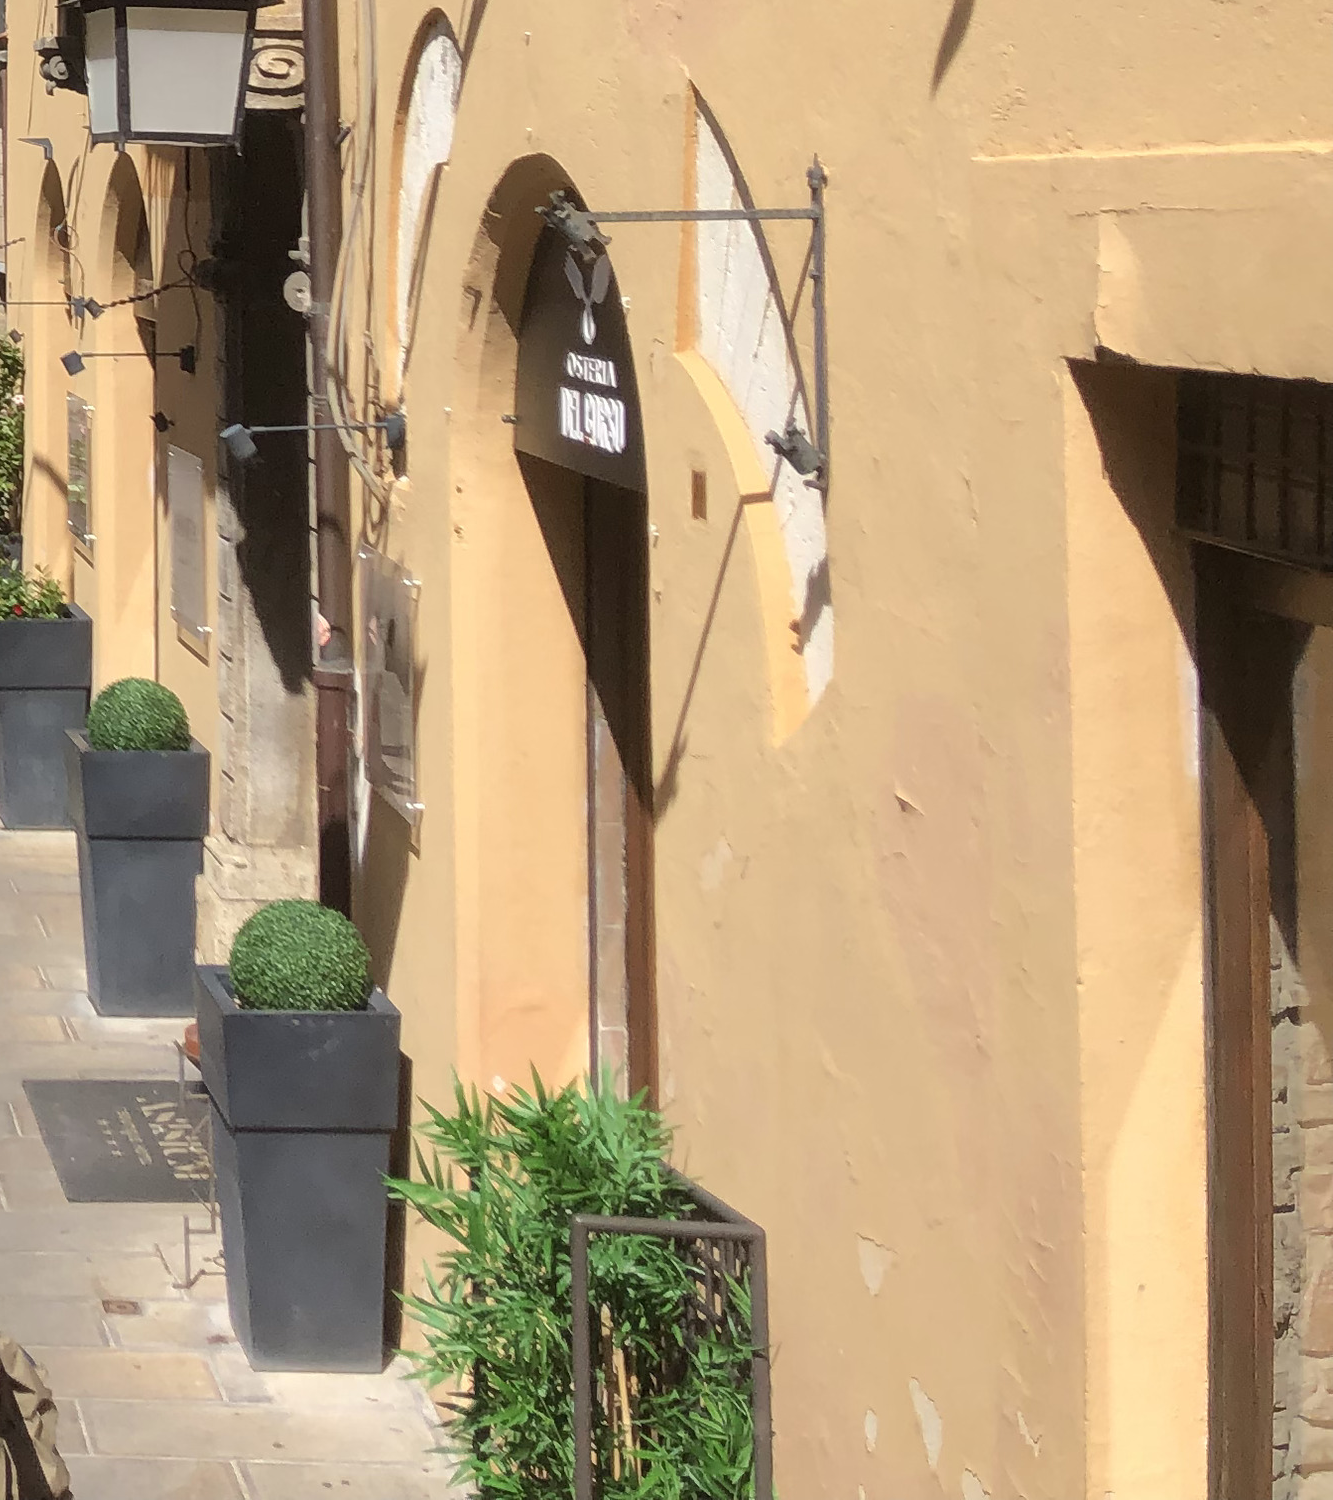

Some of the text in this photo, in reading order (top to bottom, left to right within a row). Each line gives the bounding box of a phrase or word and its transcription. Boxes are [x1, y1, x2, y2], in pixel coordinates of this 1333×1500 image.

[566, 351, 617, 389] OSTERIA
[559, 386, 626, 454] DEL CORSO
